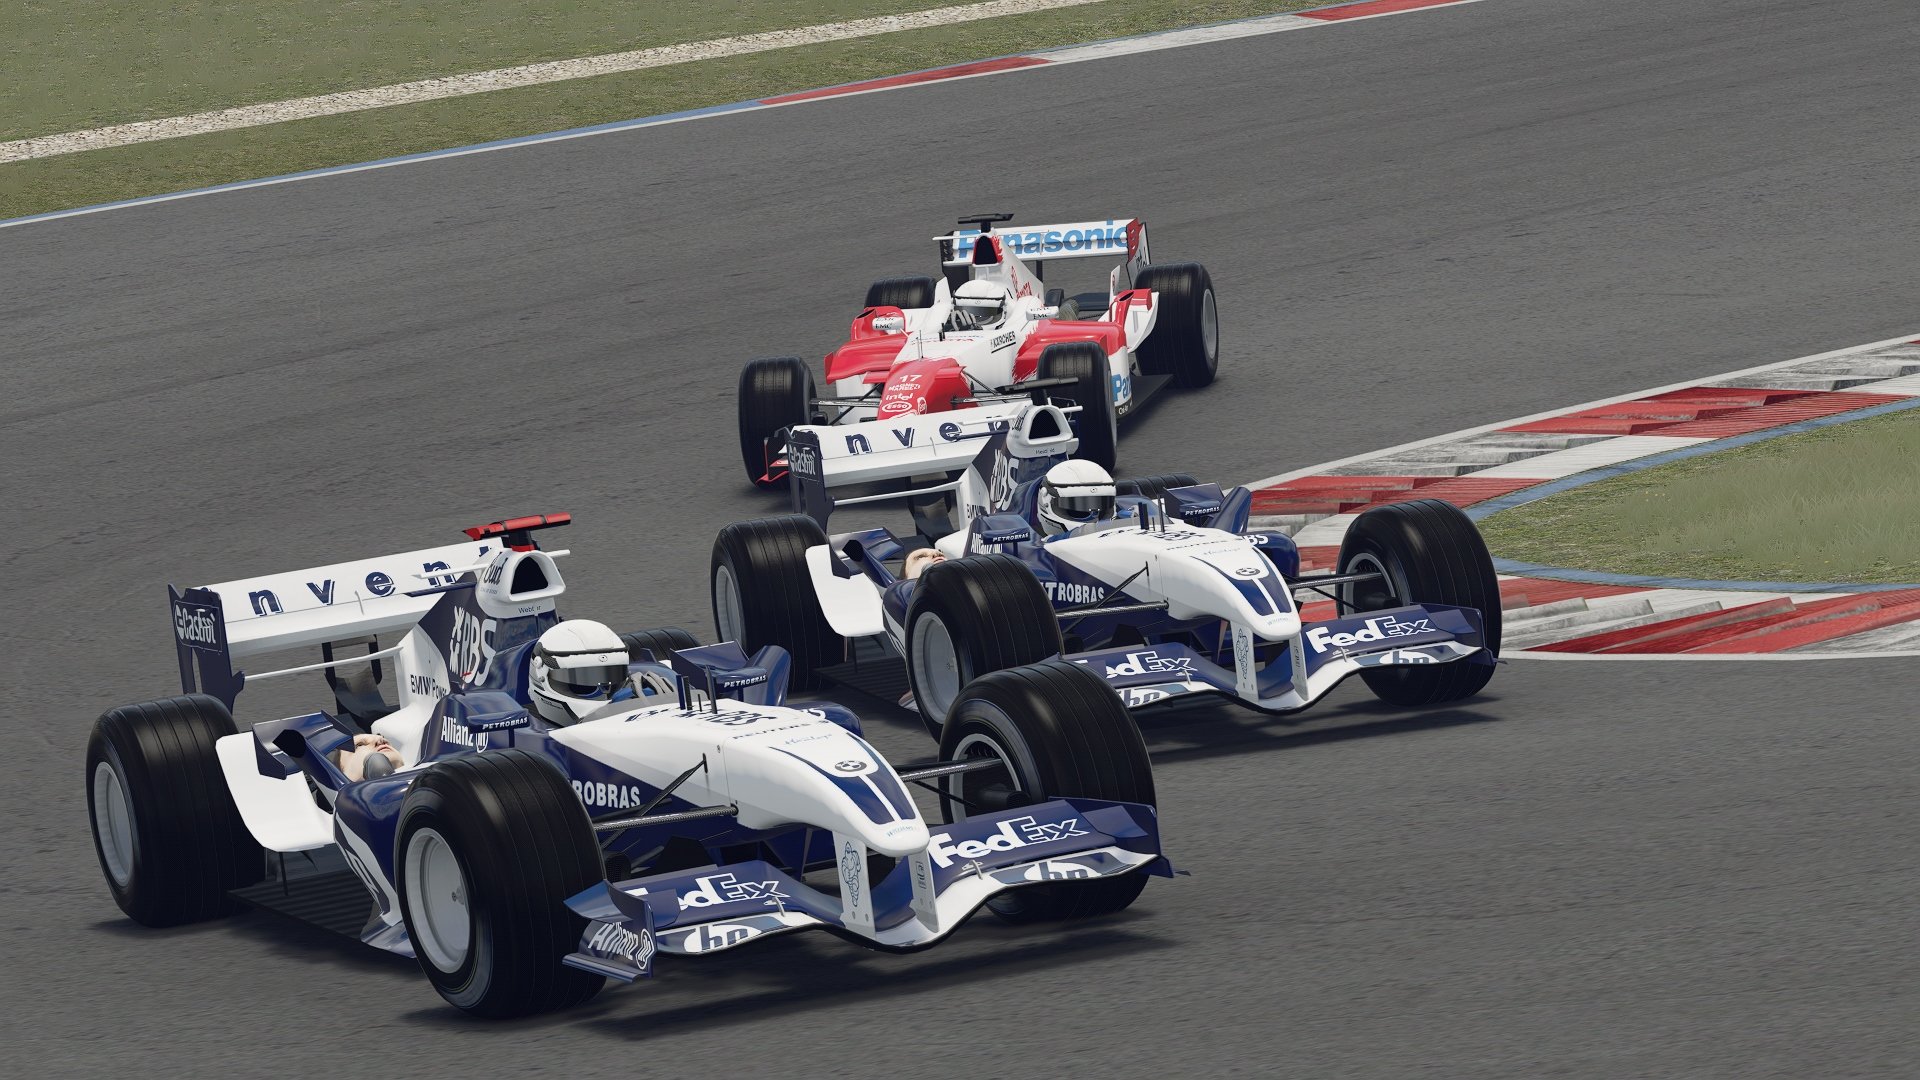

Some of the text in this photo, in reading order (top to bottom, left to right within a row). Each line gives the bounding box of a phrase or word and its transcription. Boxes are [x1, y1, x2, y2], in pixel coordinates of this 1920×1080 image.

[958, 220, 1127, 260] Pnasonic
[900, 374, 922, 382] 17
[993, 532, 1029, 543] PETROBRAS
[1039, 582, 1105, 604] TROBRAS
[1306, 616, 1436, 654] FedEx
[724, 674, 767, 688] PETROBRAS
[441, 716, 474, 747] Allianz
[482, 717, 528, 730] PETROBRAS
[569, 779, 641, 809] ROBRAS
[927, 815, 1091, 869] FedEx
[588, 921, 639, 961] Allianz
